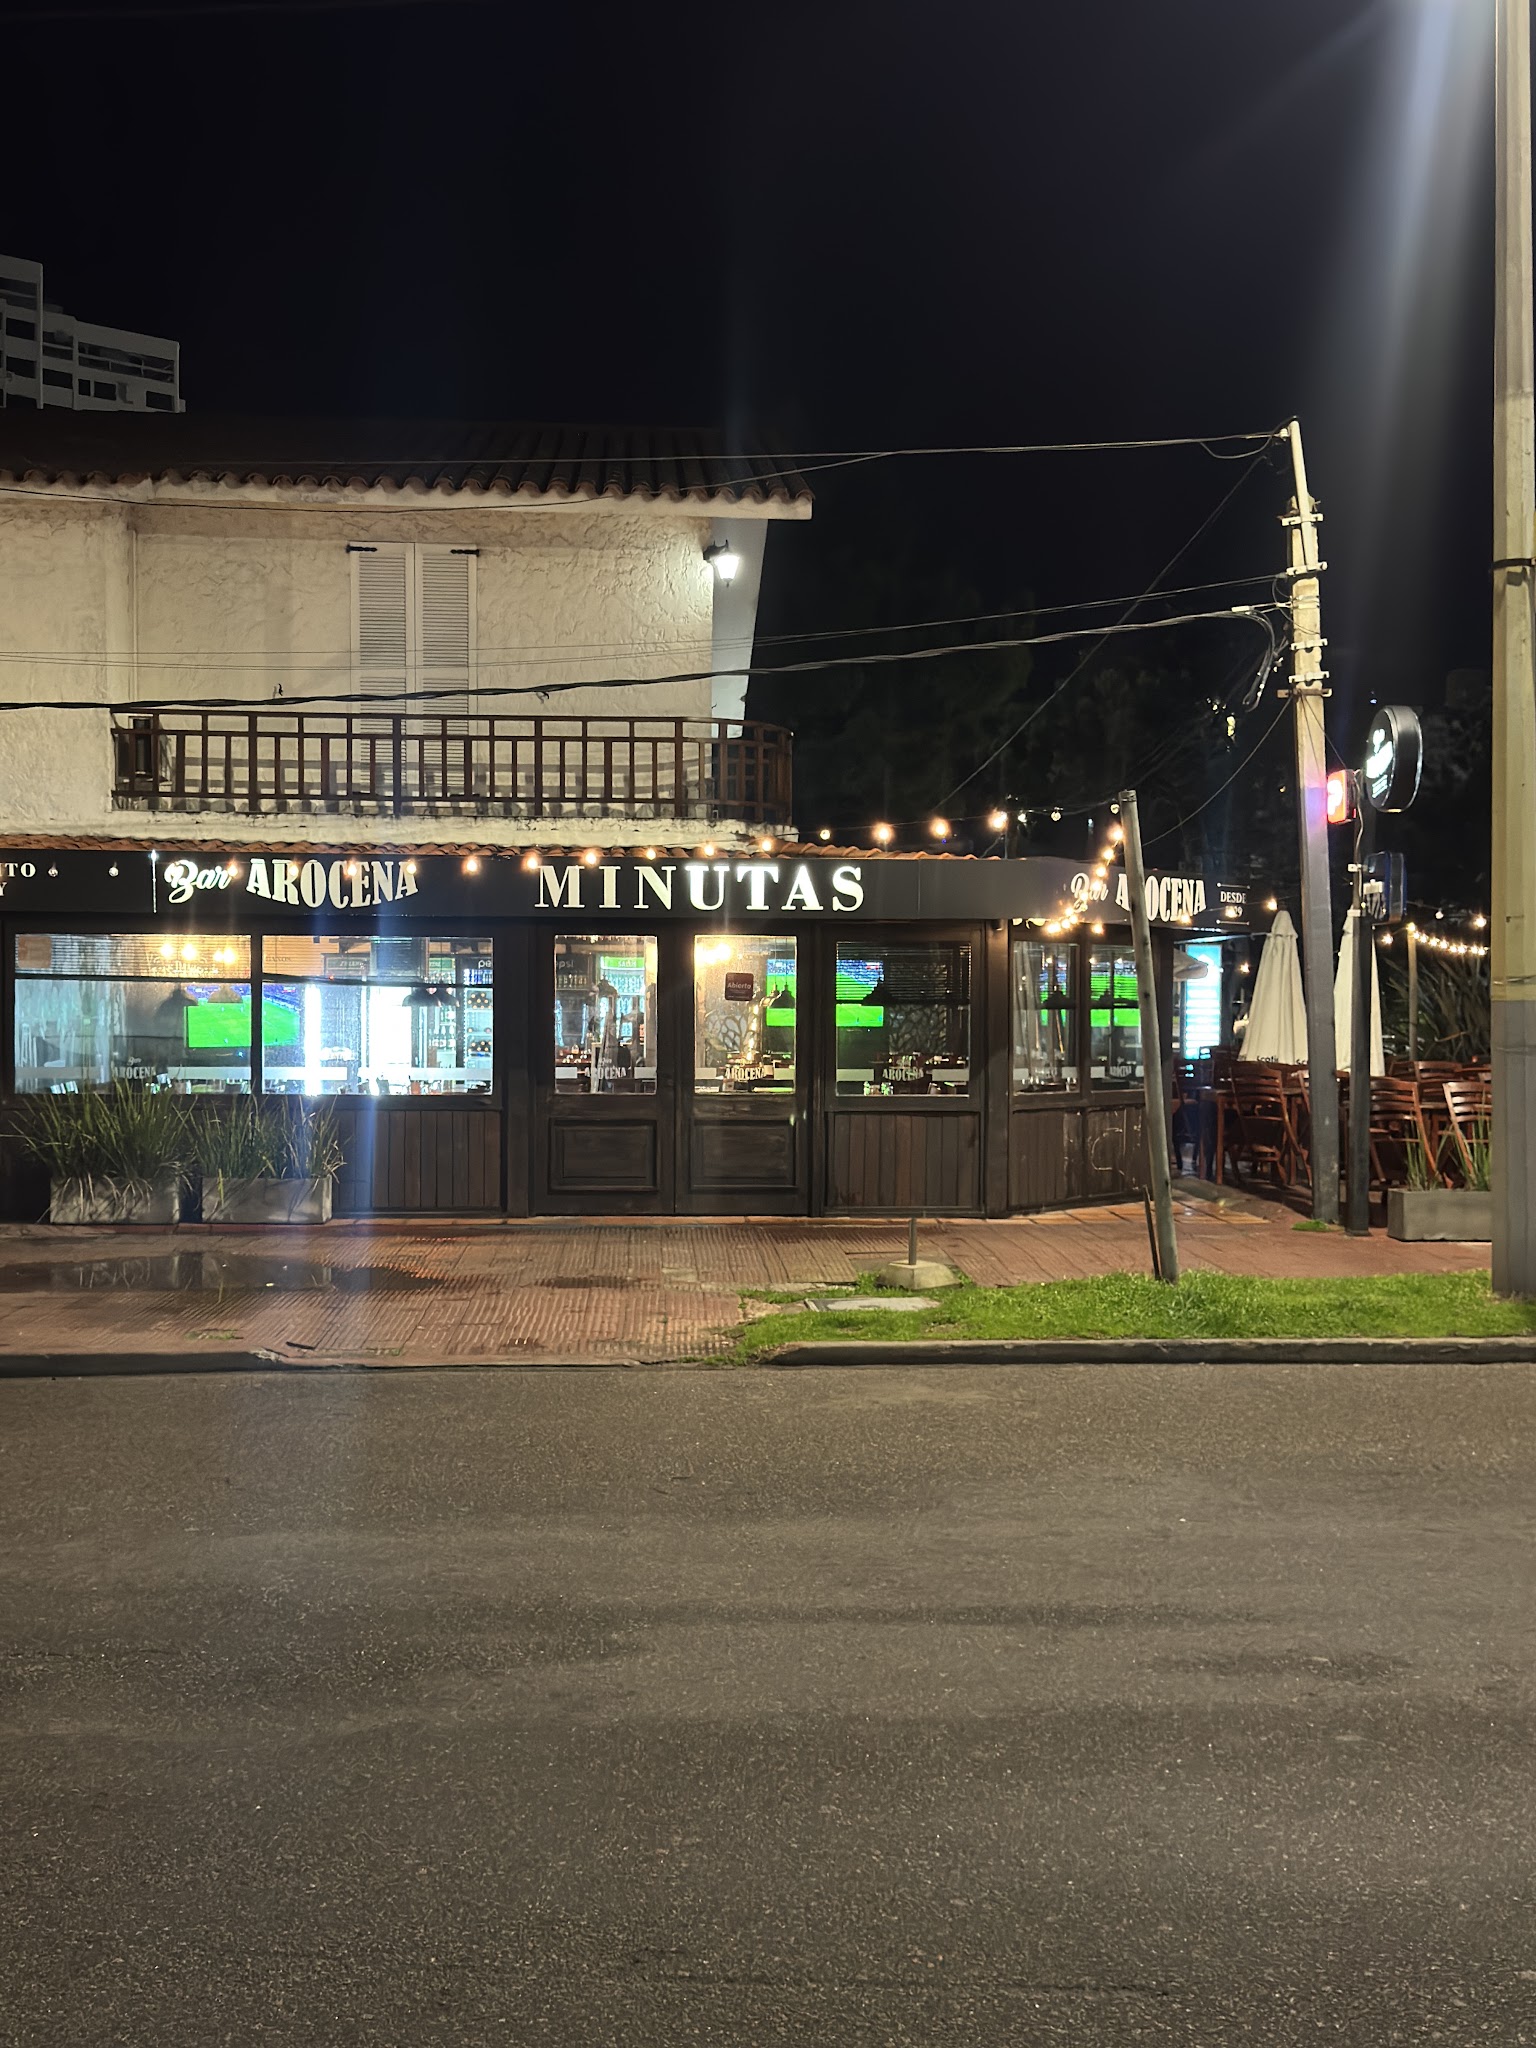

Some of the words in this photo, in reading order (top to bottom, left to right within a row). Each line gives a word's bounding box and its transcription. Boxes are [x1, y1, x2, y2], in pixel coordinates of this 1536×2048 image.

[164, 859, 231, 904] Bar
[245, 858, 419, 909] AROCENA
[534, 864, 865, 912] MINUTAS
[1115, 873, 1207, 923] AOCENA
[1220, 890, 1247, 905] DESDE
[727, 982, 752, 990] Abierto
